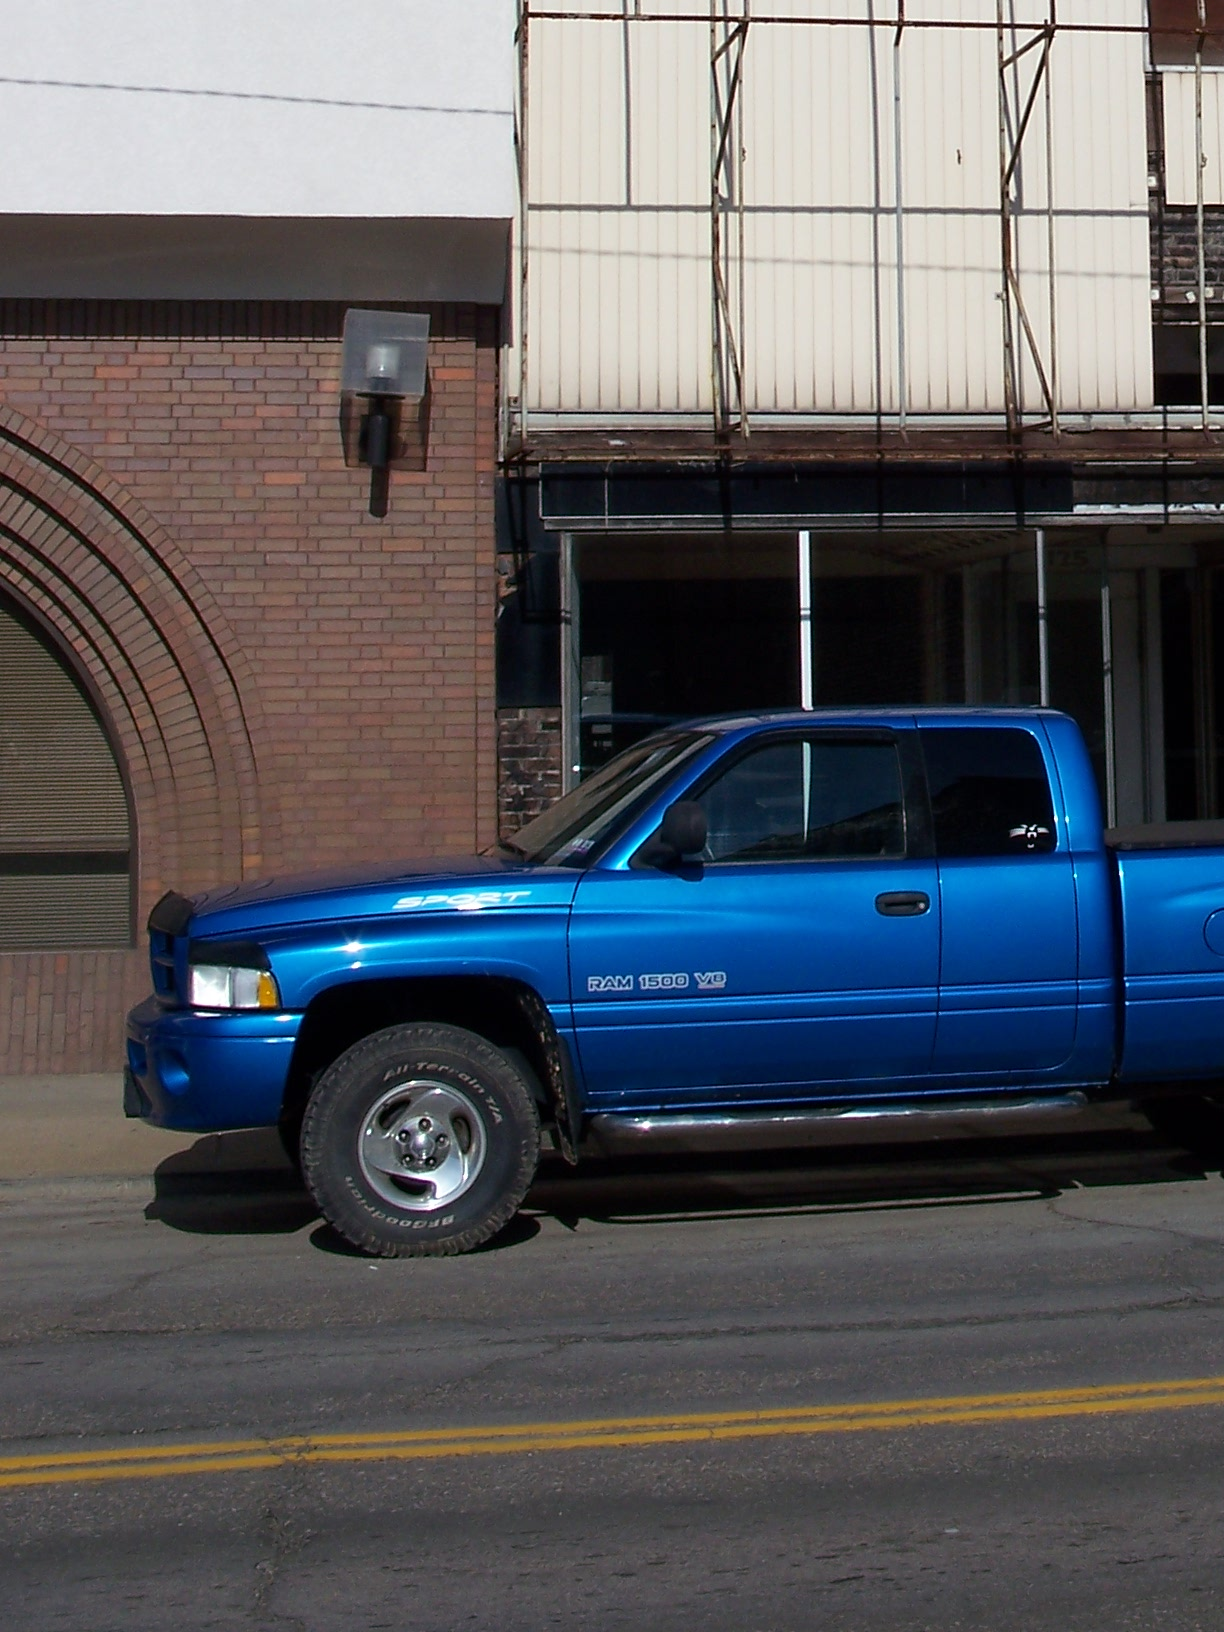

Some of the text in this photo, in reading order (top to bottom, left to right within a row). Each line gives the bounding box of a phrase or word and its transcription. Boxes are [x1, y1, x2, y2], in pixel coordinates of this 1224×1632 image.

[391, 891, 532, 910] SPORT
[588, 971, 726, 992] RAM 1500 V8
